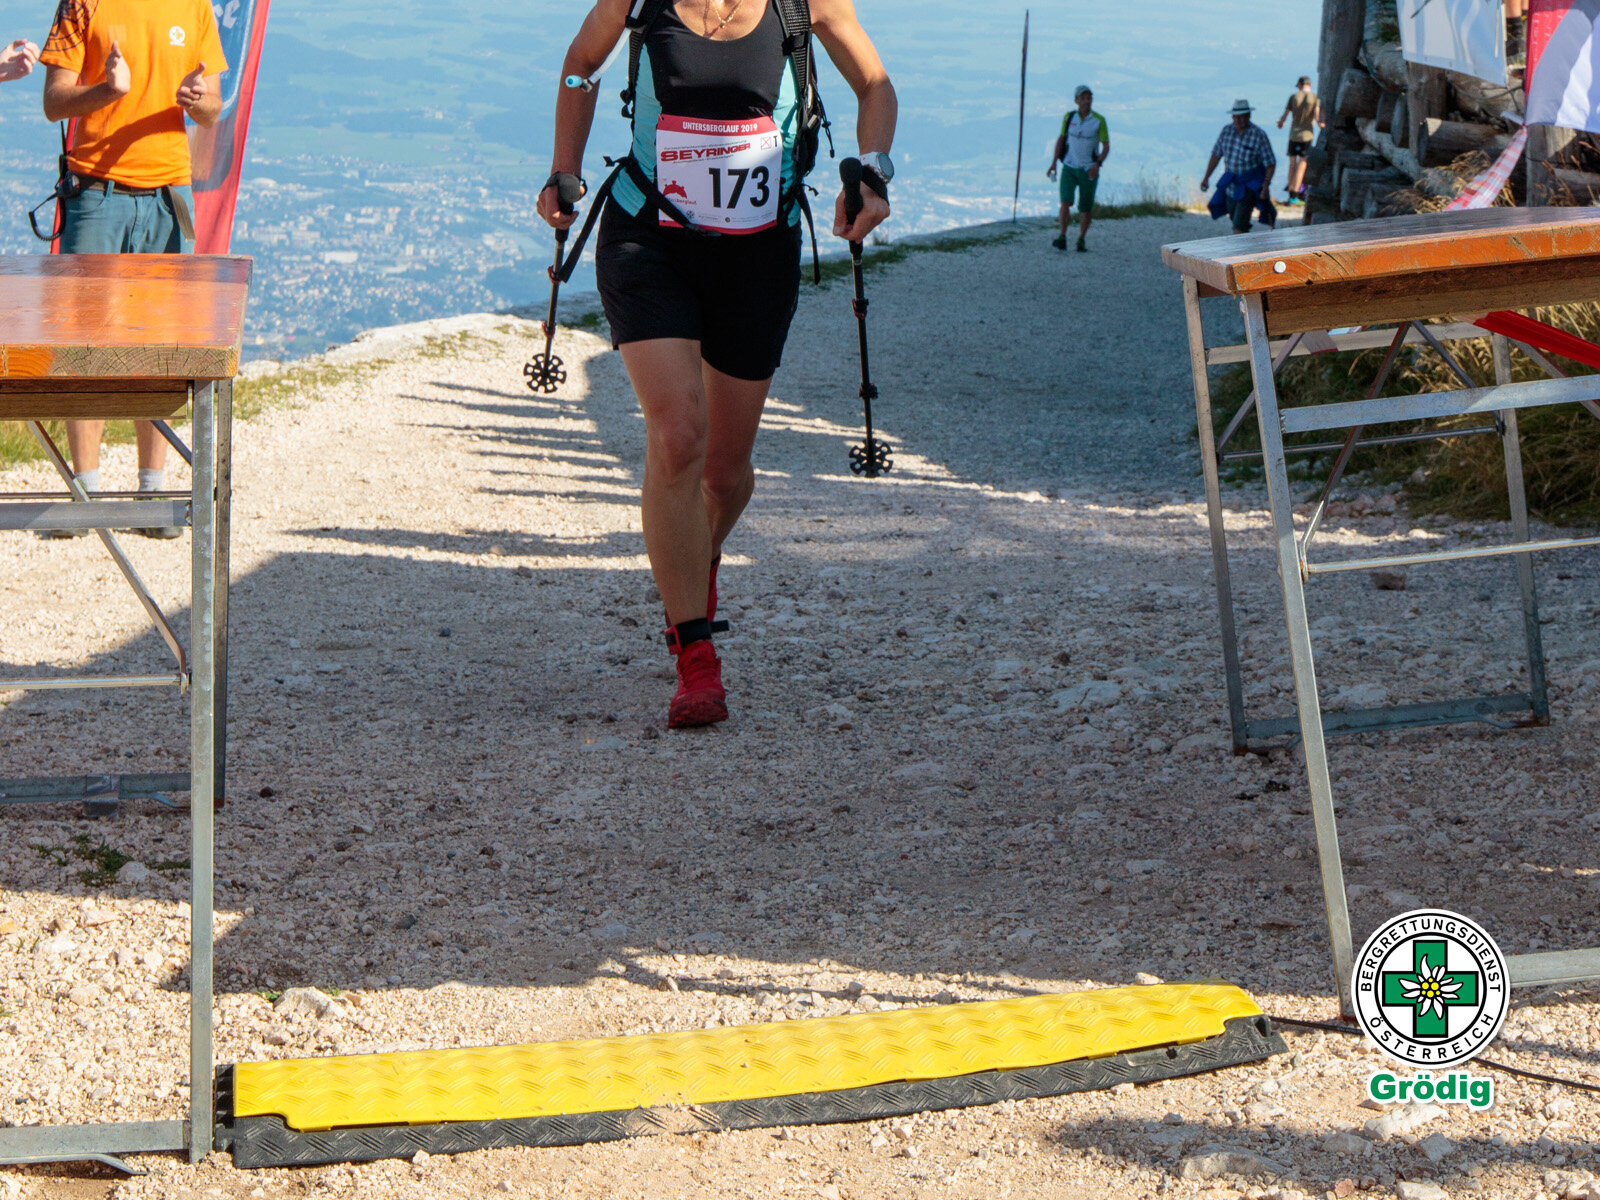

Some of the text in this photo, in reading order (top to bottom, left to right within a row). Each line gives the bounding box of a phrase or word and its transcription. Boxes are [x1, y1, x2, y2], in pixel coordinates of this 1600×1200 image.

[682, 121, 758, 133] UNTERSBERGLAUF 2019
[708, 165, 770, 209] 173
